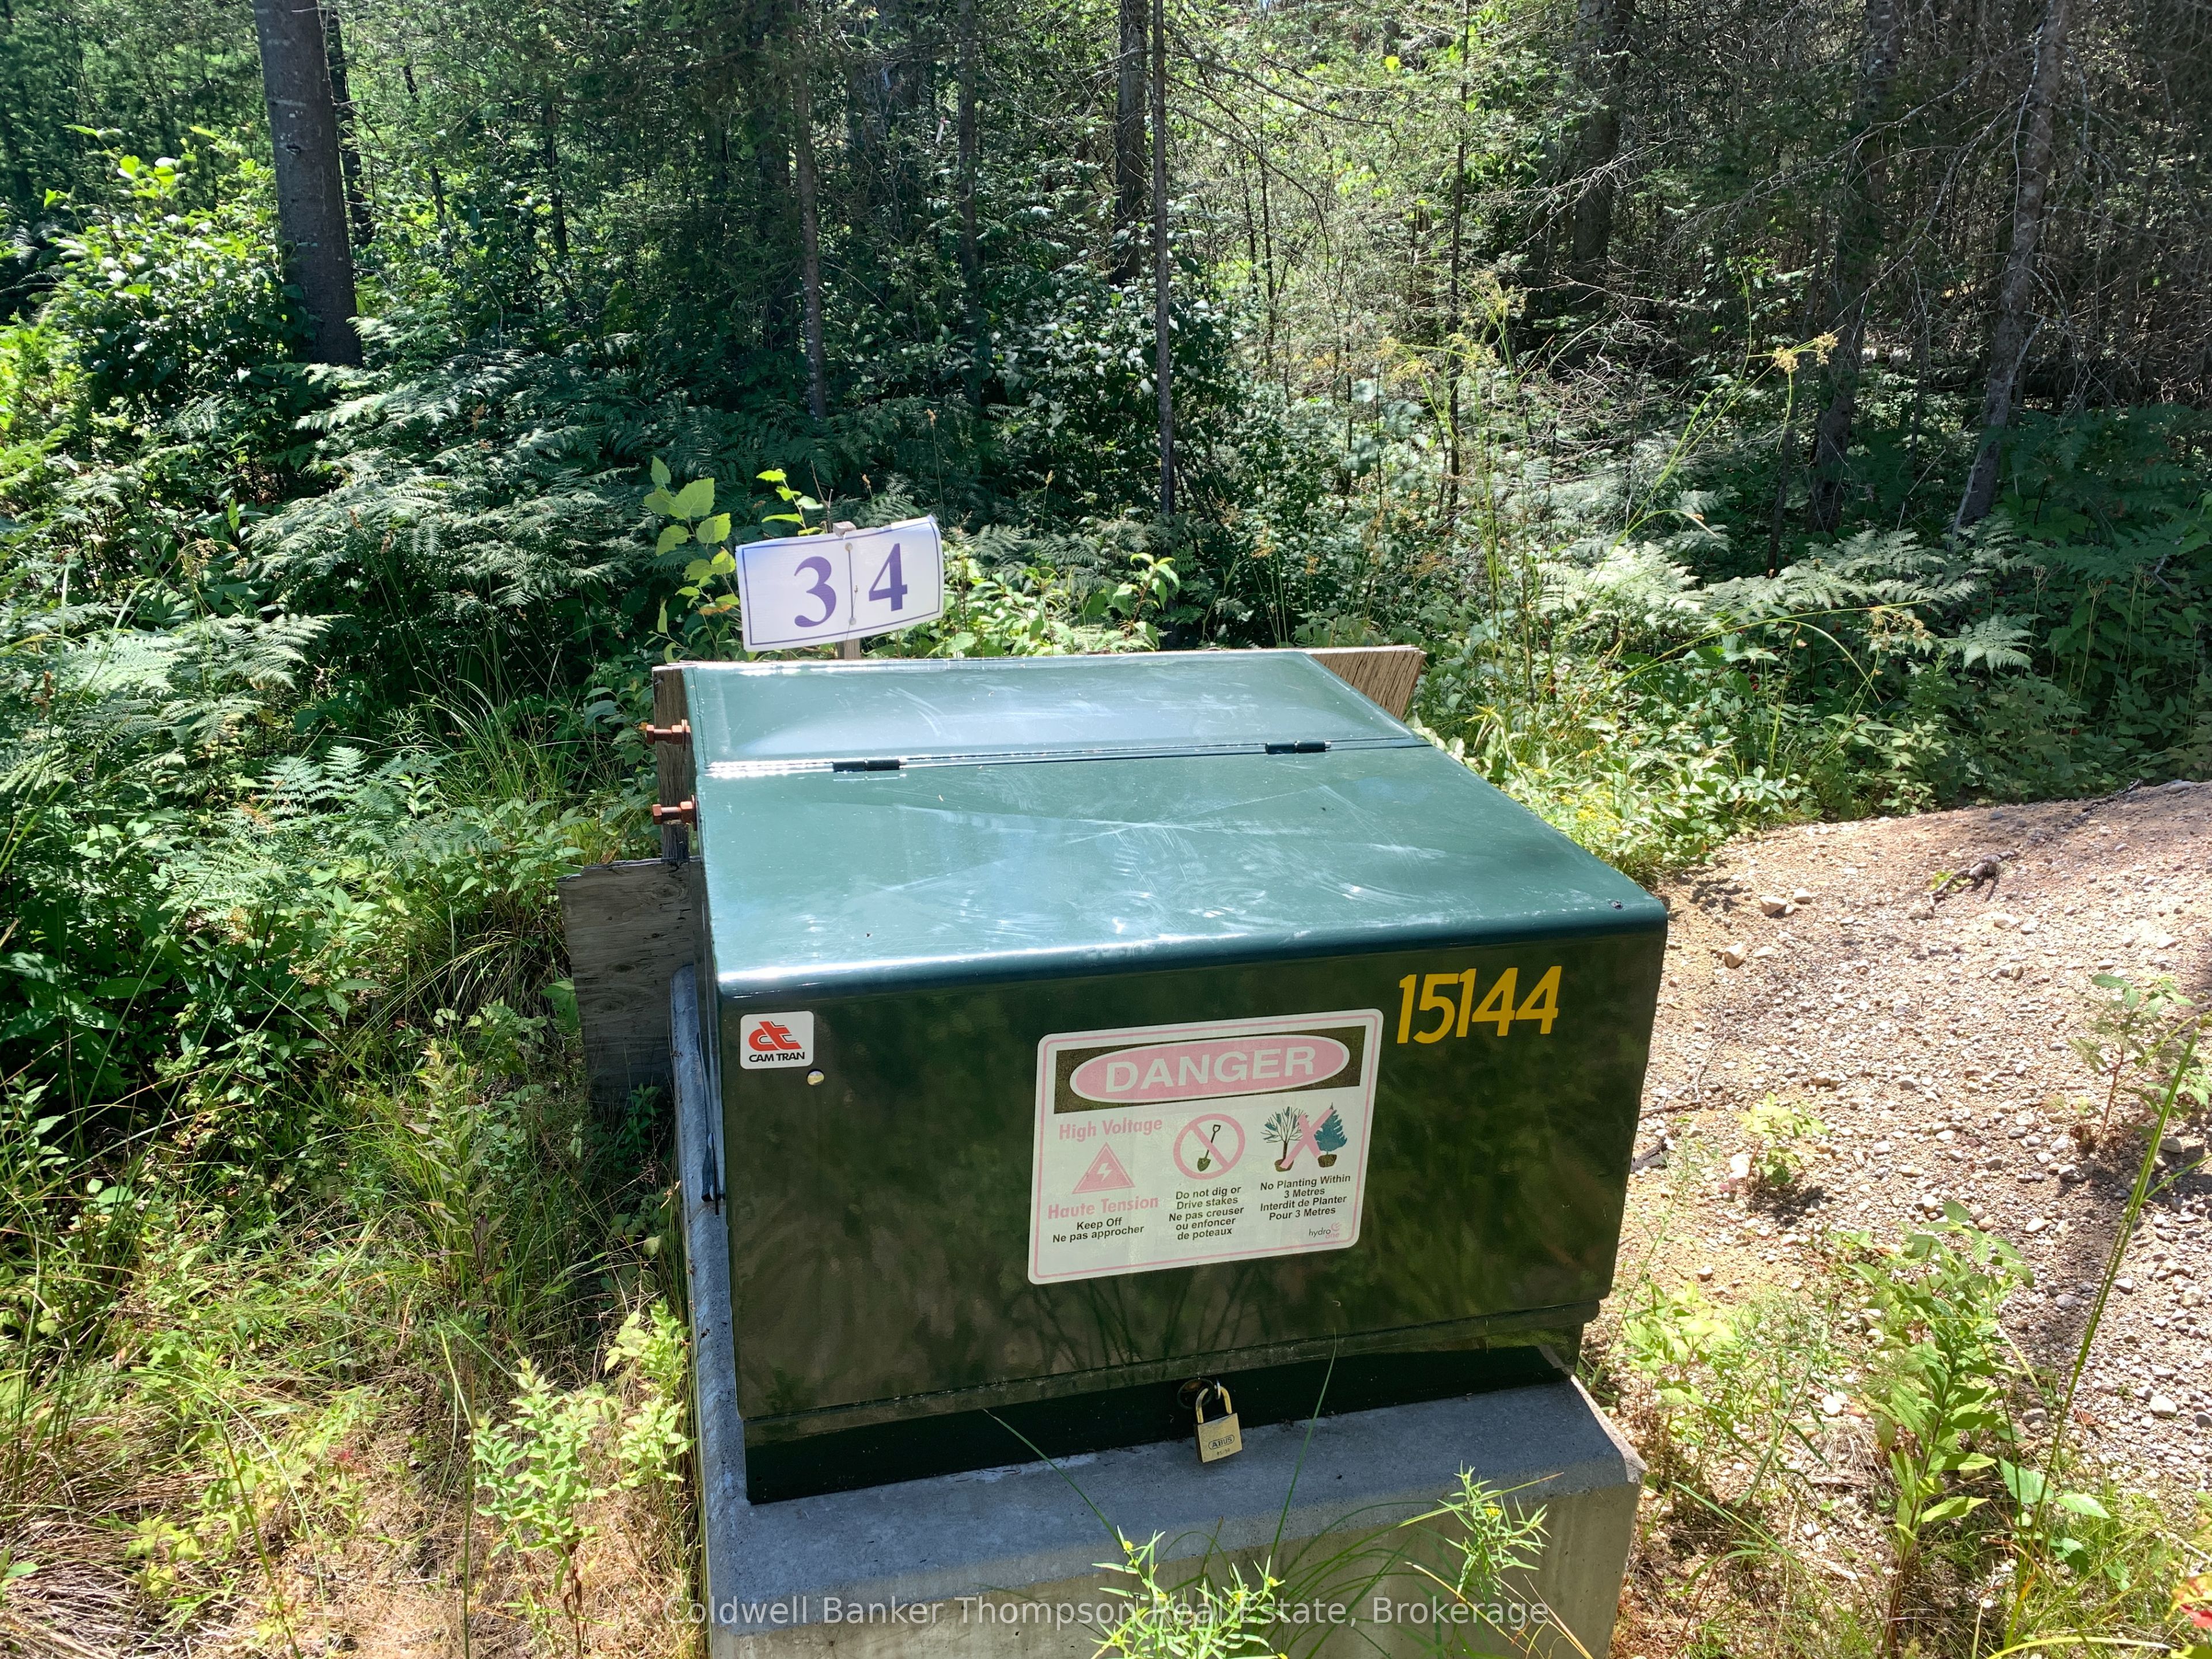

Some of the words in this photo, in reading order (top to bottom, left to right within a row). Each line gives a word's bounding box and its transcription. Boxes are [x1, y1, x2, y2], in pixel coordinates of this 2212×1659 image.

[1396, 965, 1562, 1044] 15144
[749, 1054, 774, 1062] CAM
[776, 1052, 805, 1061] TRAN
[1105, 1046, 1316, 1093] DANGER
[1059, 1121, 1096, 1142] High
[1102, 1117, 1162, 1136] Voltage
[1260, 1182, 1274, 1191] No
[1277, 1178, 1317, 1188] Planting
[1320, 1174, 1351, 1184] Within
[1176, 1191, 1190, 1199] Do
[1192, 1189, 1209, 1198] not
[1212, 1187, 1228, 1196] dig
[1284, 1190, 1289, 1198] 3
[1293, 1188, 1325, 1198] Metres
[1048, 1203, 1095, 1219] Haute
[1101, 1196, 1159, 1213] Tension
[1177, 1200, 1203, 1210] Drive
[1206, 1196, 1238, 1207] stakes
[1260, 1200, 1295, 1211] Interdit
[1298, 1199, 1309, 1207] de
[1313, 1196, 1347, 1206] Planter
[1169, 1213, 1182, 1221] Ne
[1185, 1211, 1203, 1222] pas
[1206, 1207, 1244, 1218] creuser
[1269, 1211, 1293, 1221] Pour
[1304, 1207, 1336, 1217] Metres
[1077, 1221, 1103, 1231] Keep
[1106, 1217, 1123, 1226] Off
[1191, 1218, 1236, 1229] enfoncer
[1052, 1234, 1066, 1243] Ne
[1070, 1232, 1088, 1243] pas
[1092, 1225, 1145, 1239] approcher
[1177, 1232, 1190, 1240] de
[1192, 1228, 1232, 1240] poteaux
[1309, 1227, 1331, 1238] hydro
[1212, 1436, 1232, 1448] ABUS
